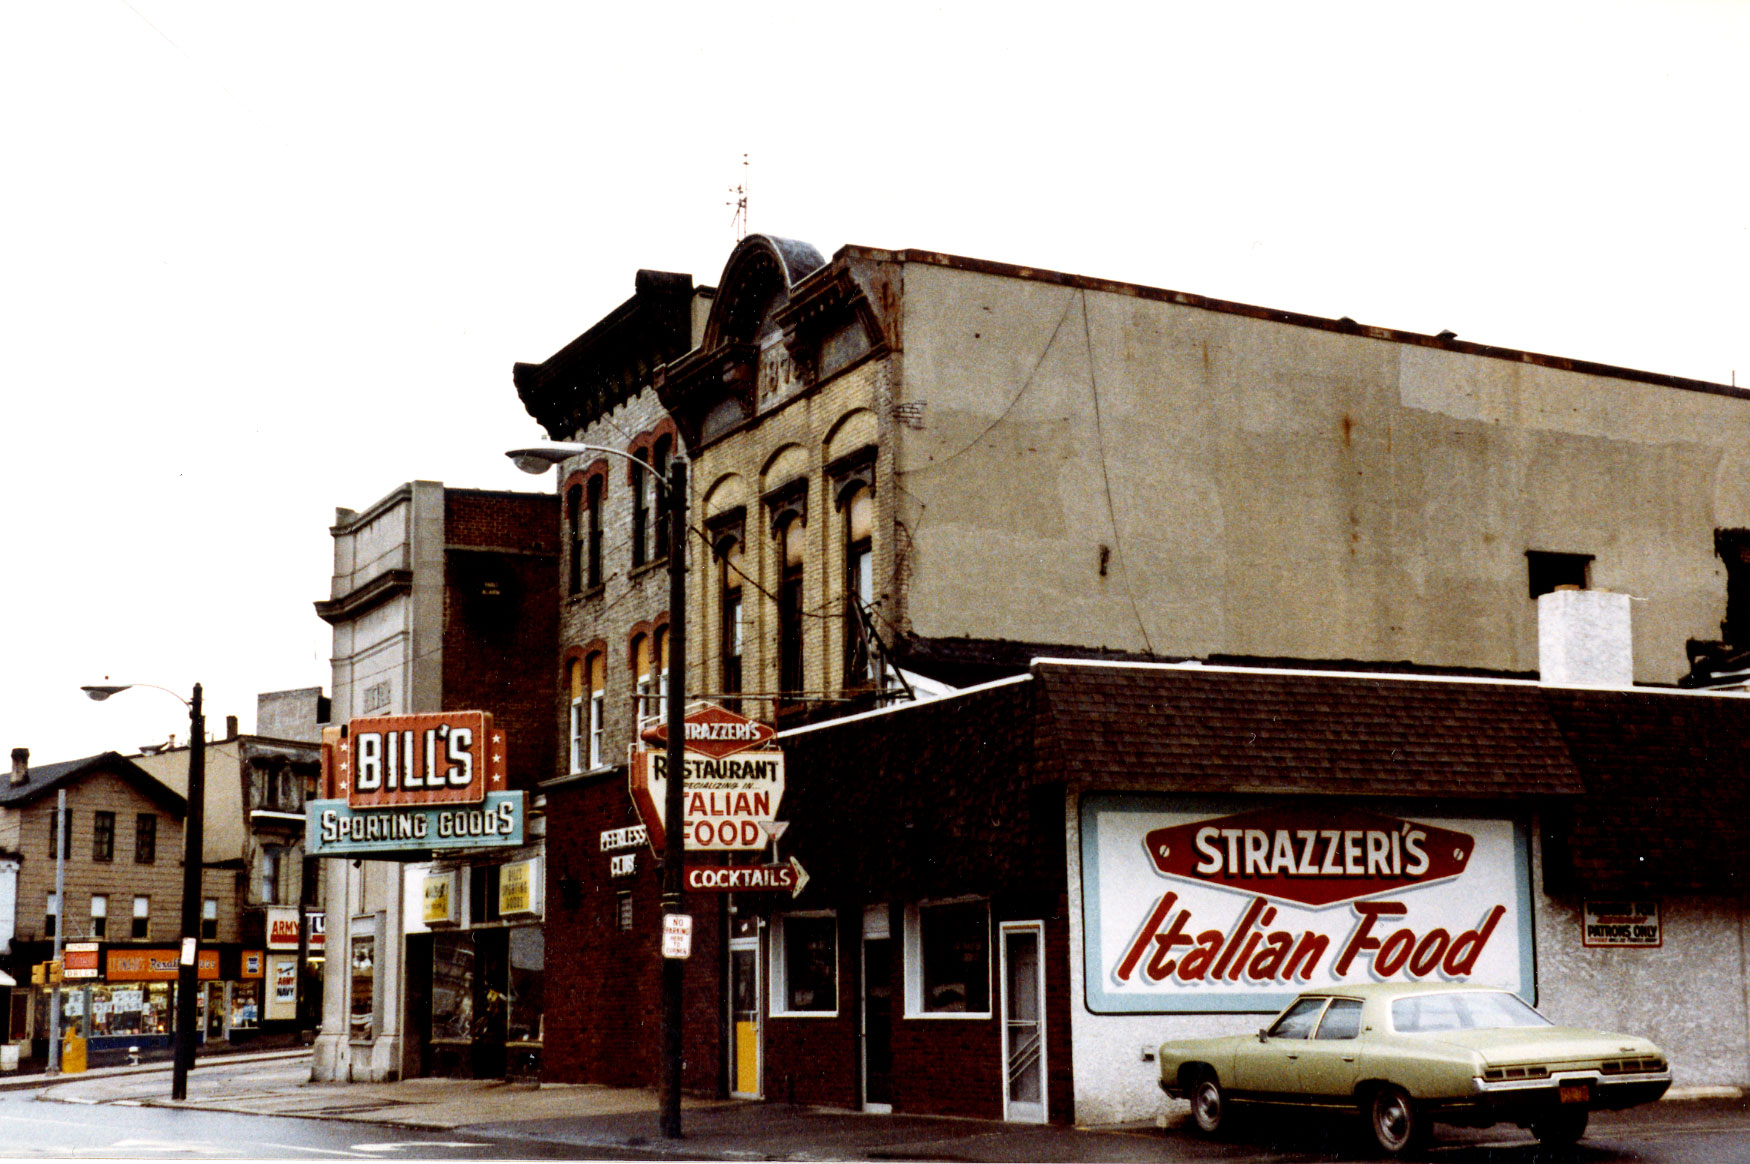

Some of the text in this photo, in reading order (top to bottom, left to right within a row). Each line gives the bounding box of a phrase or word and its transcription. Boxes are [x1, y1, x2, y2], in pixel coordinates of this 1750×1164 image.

[684, 720, 762, 740] TRAZZERI'S
[356, 723, 473, 791] BILL'S
[653, 755, 779, 783] RSTAURANT
[684, 782, 739, 790] PECIALIZING
[322, 801, 514, 843] SPORTING GOODS
[1196, 823, 1430, 877] STRAZZERI'S
[689, 868, 792, 888] COCKTAILS
[272, 921, 299, 935] ARMY
[1117, 891, 1507, 981] Italian Food
[1587, 925, 1658, 938] PATRONS ONLY
[278, 977, 294, 985] ARMY
[277, 987, 294, 997] NAVY
